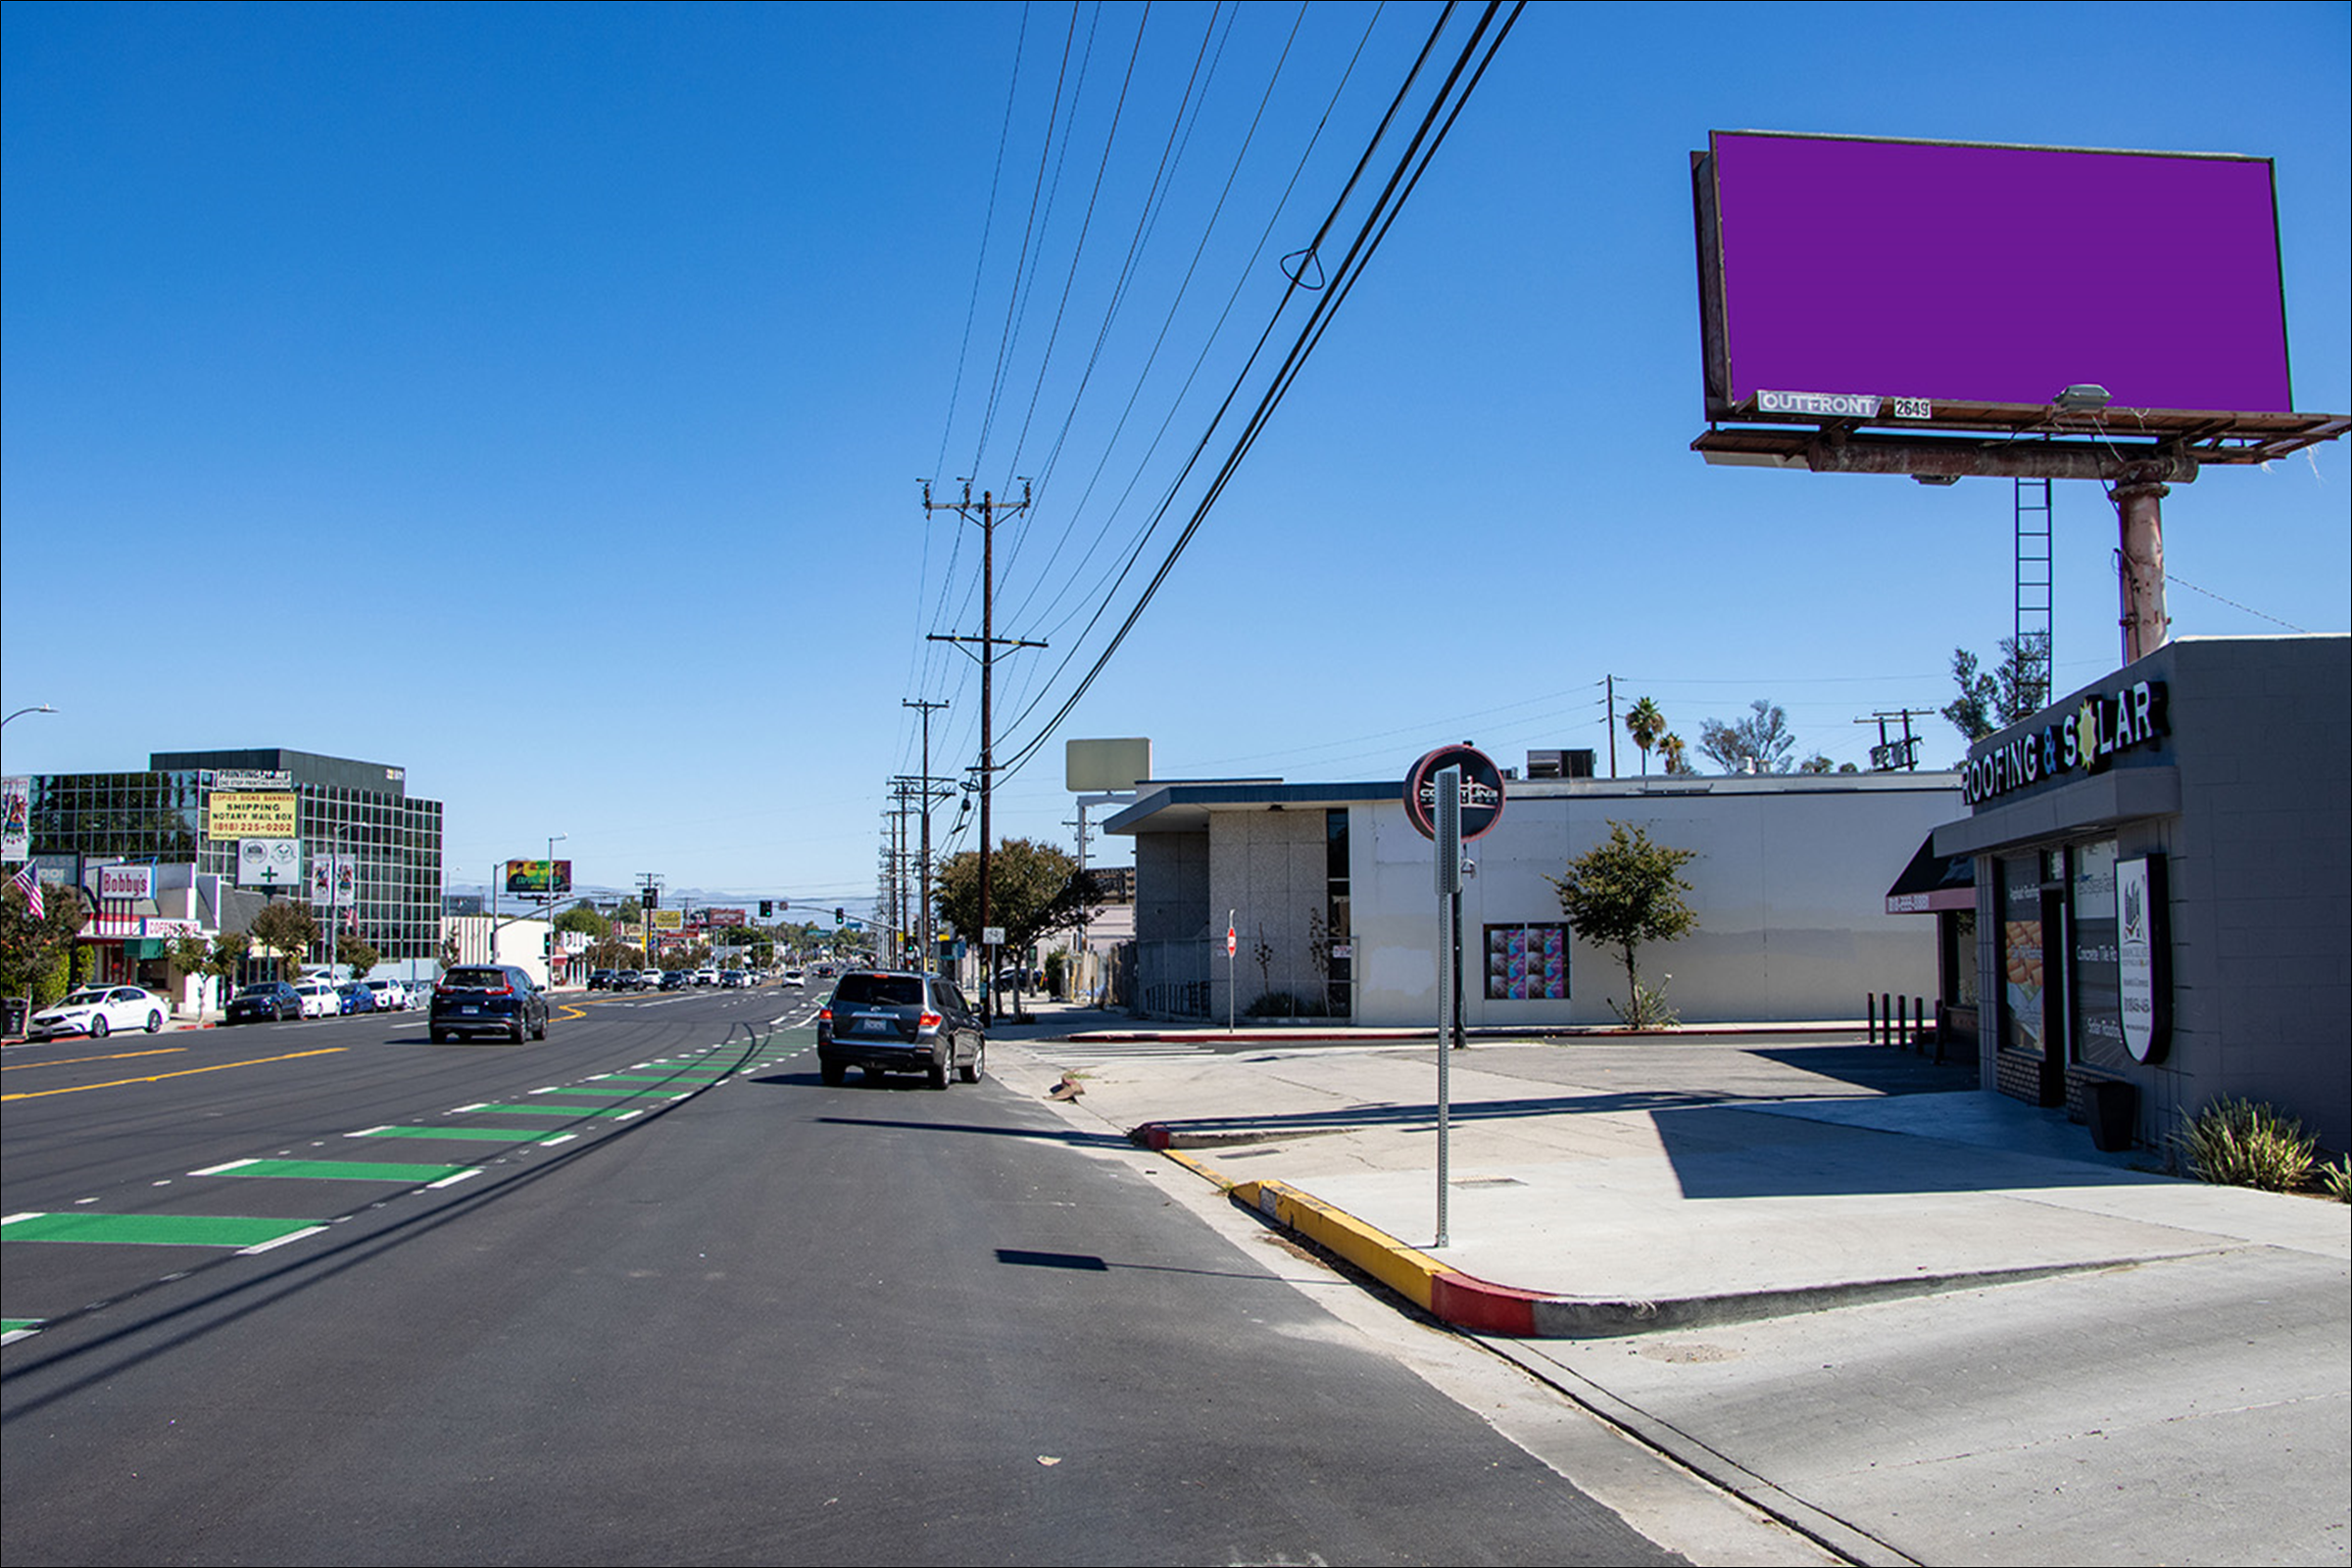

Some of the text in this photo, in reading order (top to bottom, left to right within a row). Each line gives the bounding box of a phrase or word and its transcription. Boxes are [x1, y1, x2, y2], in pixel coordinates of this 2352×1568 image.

[1763, 393, 1876, 415] OUTFRONT
[1896, 400, 1930, 416] 2649
[1962, 680, 2153, 806] ROOFING & SOLAR
[219, 770, 260, 779] PRINTING
[1419, 788, 1498, 798] COTLINE
[214, 822, 238, 831] (818)
[30, 856, 76, 866] RASS
[104, 873, 147, 897] Bobby's
